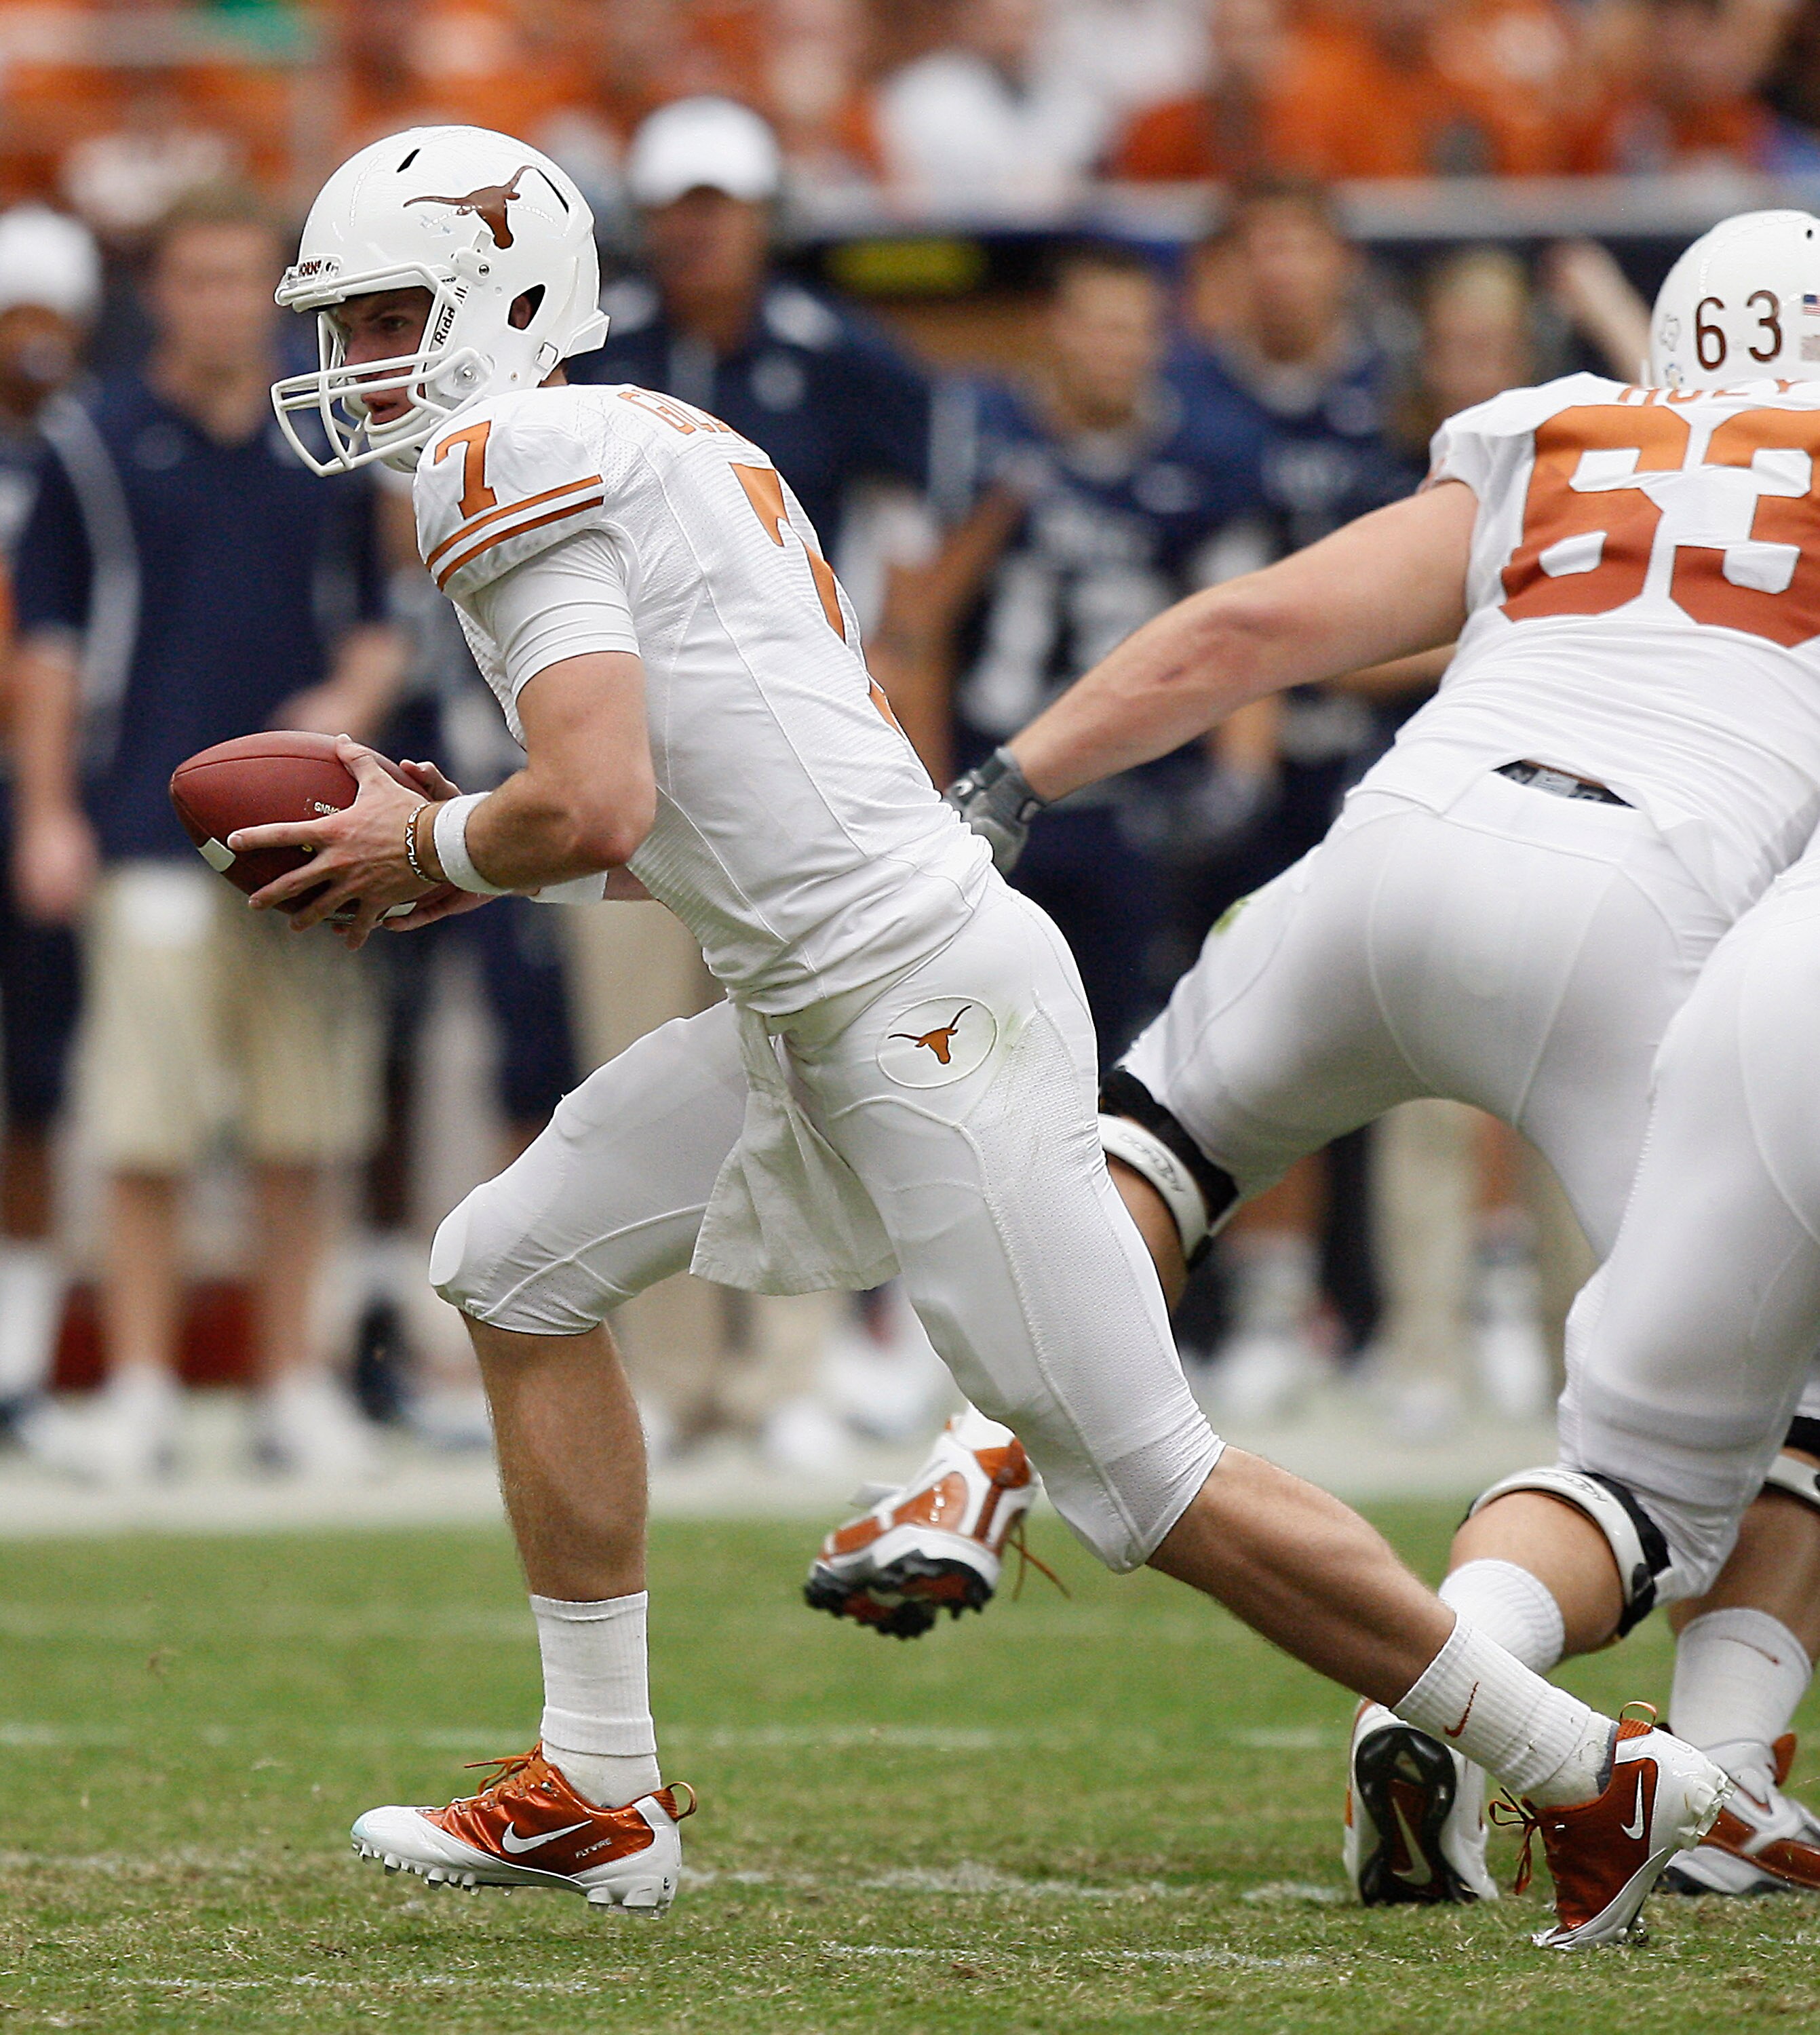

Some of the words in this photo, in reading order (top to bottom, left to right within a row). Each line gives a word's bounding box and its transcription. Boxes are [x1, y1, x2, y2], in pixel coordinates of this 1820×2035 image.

[1696, 290, 1782, 370] 63
[433, 420, 498, 520] 7
[1498, 405, 1820, 649] 63
